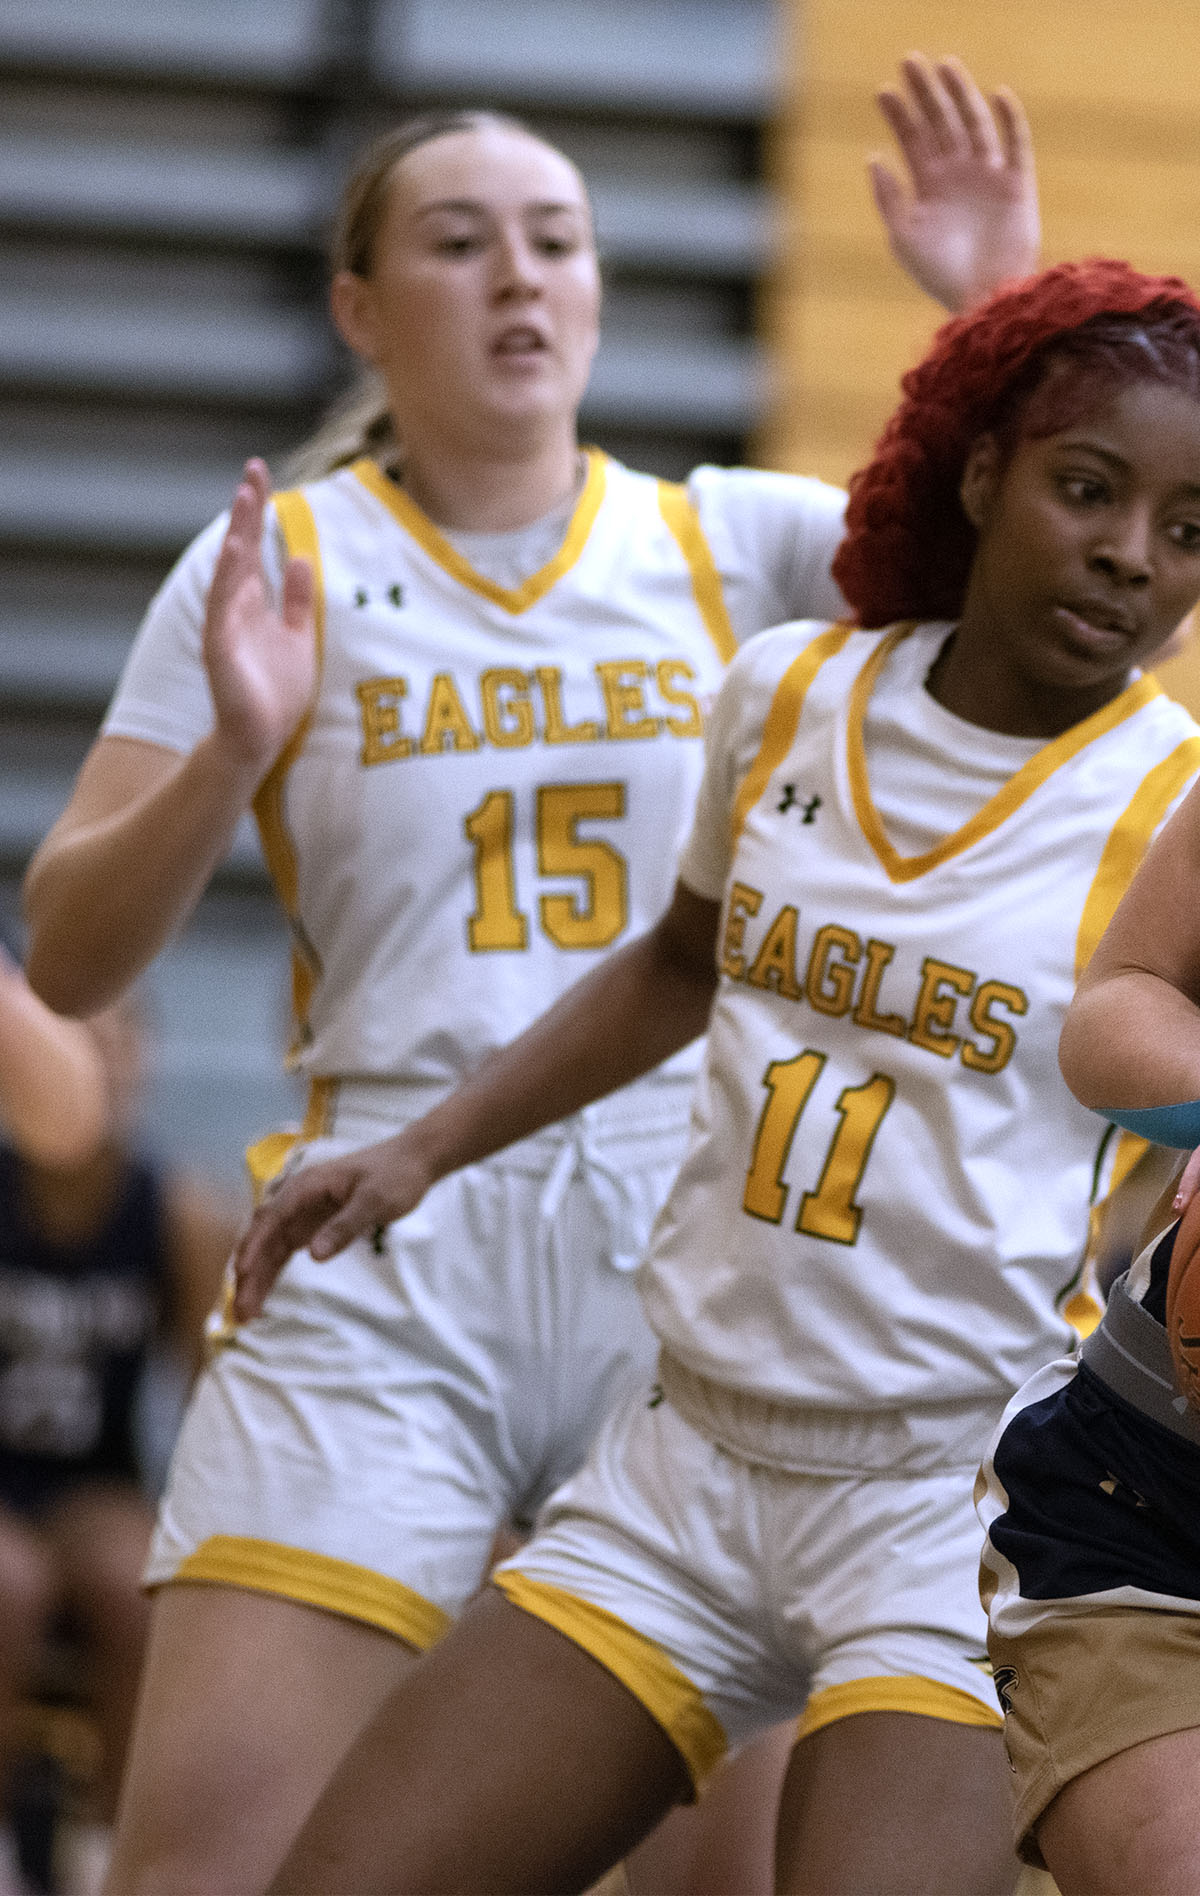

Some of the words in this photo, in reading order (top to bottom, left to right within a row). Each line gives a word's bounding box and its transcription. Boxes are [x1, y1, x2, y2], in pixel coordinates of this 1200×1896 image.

[356, 659, 703, 766] EAGLES
[464, 783, 628, 953] 15
[720, 881, 1028, 1075] EAGLES
[743, 1048, 896, 1246] 11
